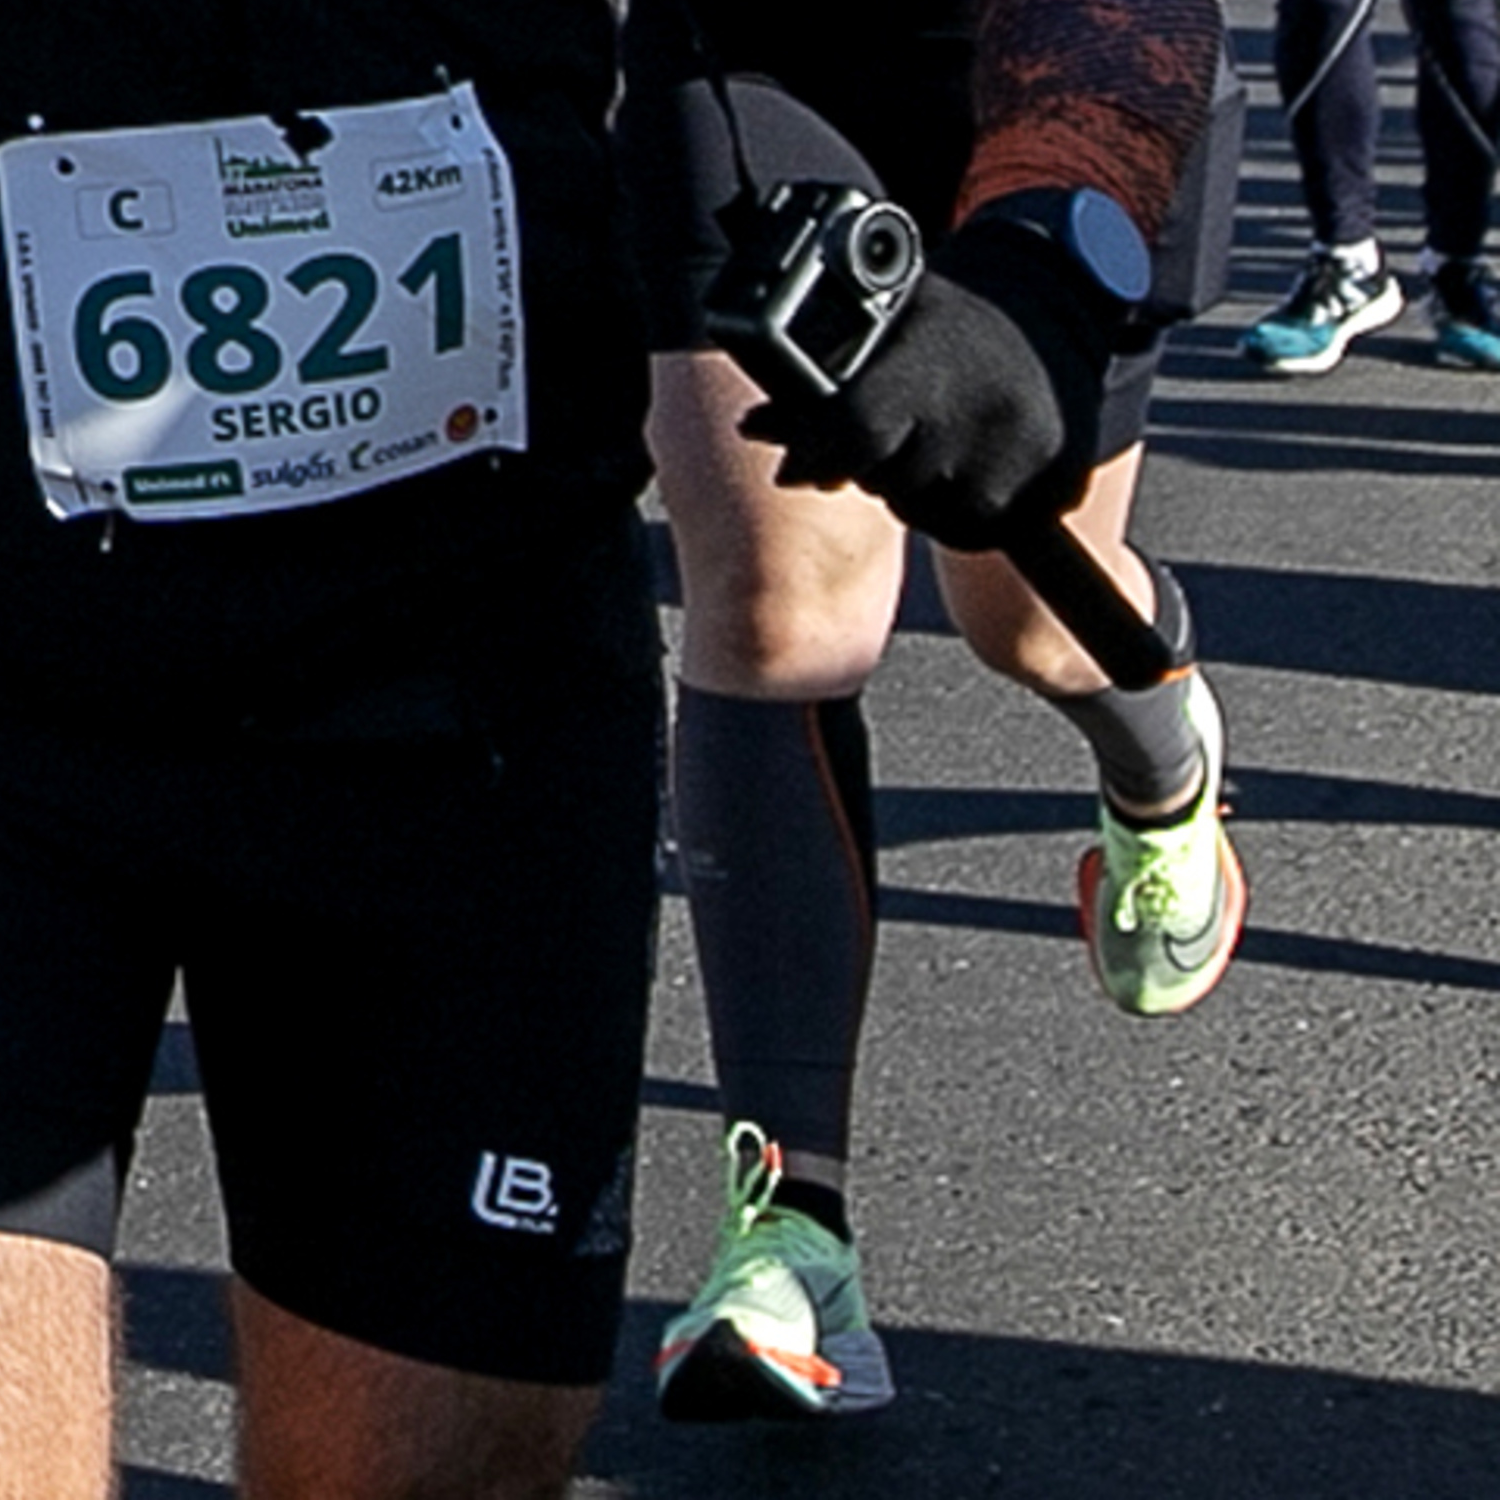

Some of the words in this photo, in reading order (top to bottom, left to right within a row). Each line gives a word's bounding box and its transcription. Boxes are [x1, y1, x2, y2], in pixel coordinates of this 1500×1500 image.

[376, 164, 463, 197] 42Km
[108, 190, 144, 230] C
[226, 211, 331, 238] Unimed
[73, 232, 467, 403] 6821
[211, 386, 382, 442] SERGIO
